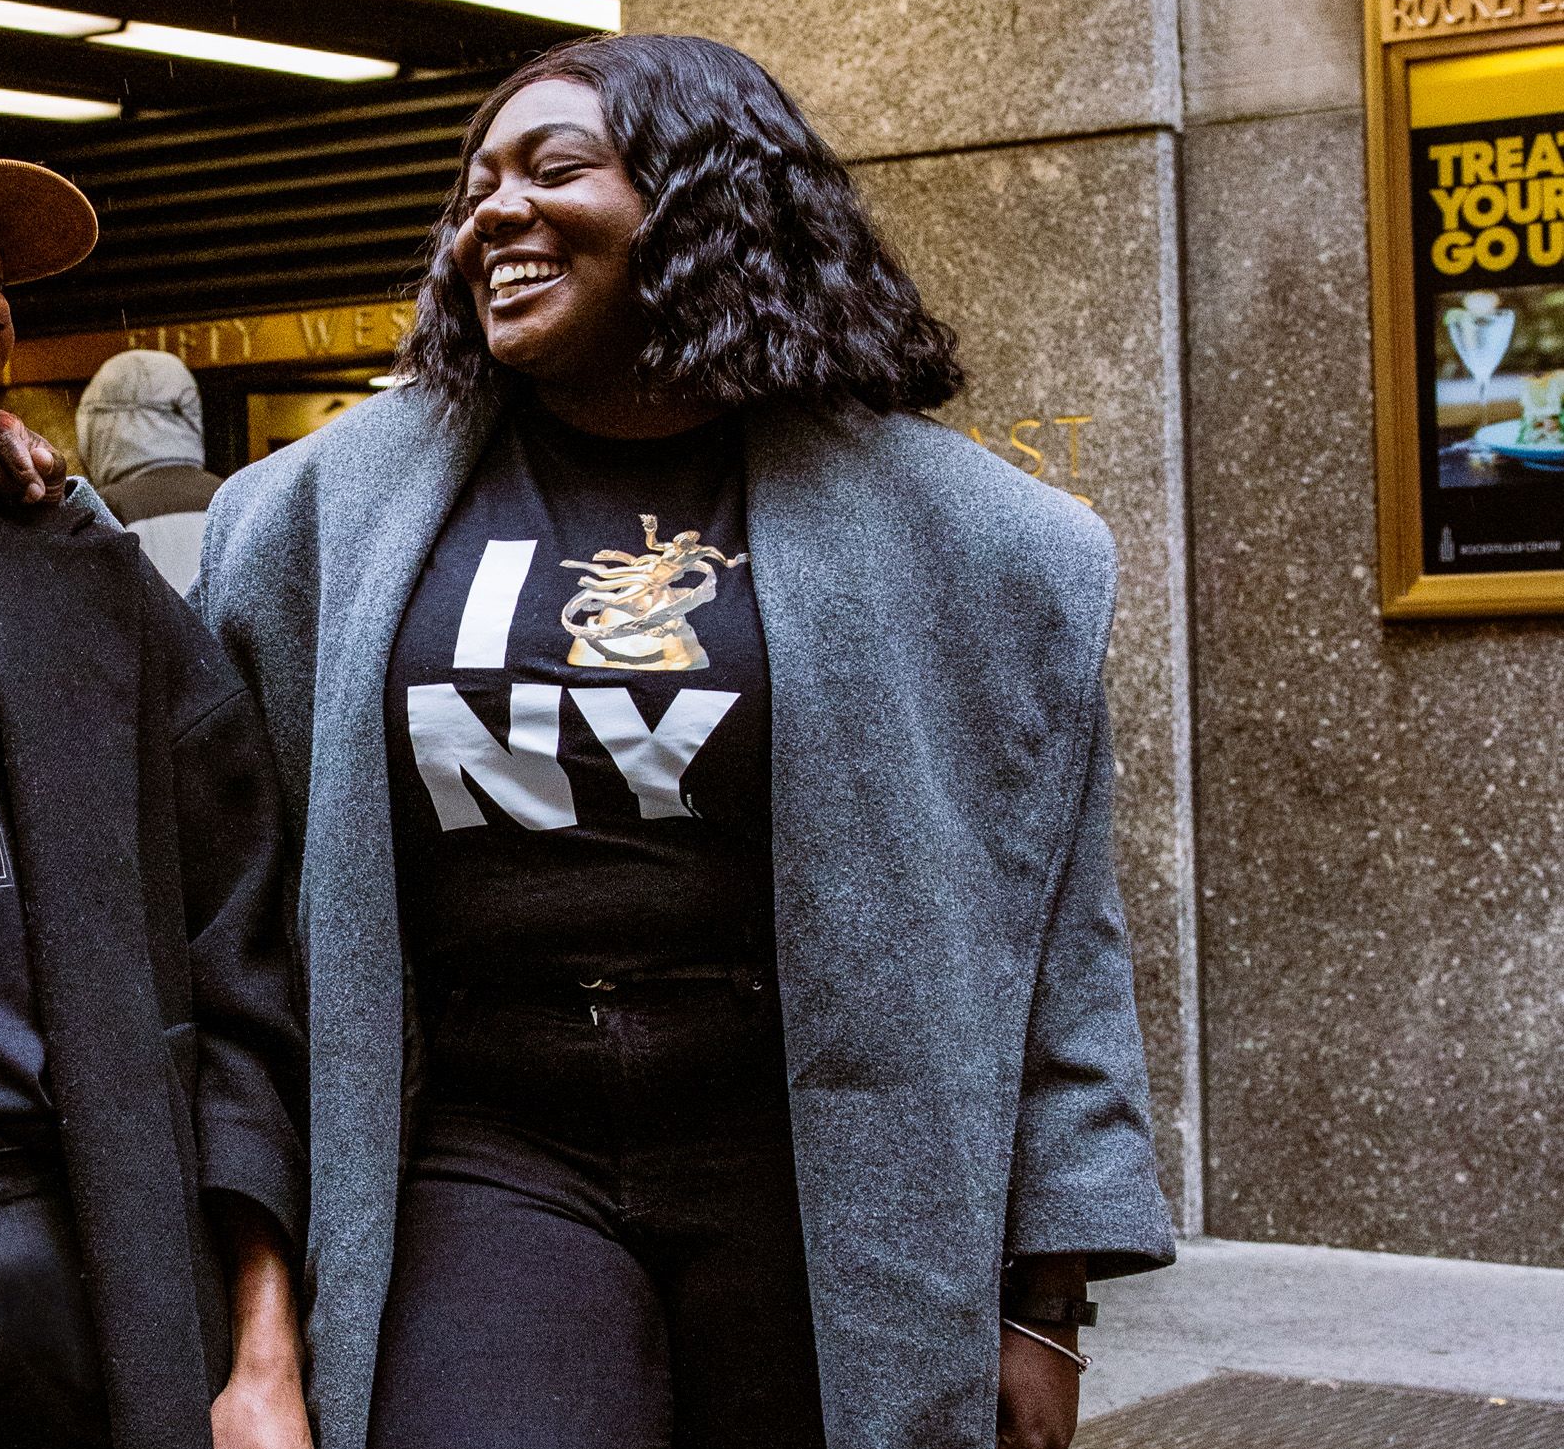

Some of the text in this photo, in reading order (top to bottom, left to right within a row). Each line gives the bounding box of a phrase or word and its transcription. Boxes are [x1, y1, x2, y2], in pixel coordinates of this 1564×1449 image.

[1428, 130, 1564, 188] TREA
[1431, 226, 1519, 275] GO
[453, 539, 538, 669] I
[407, 682, 741, 832] NY
